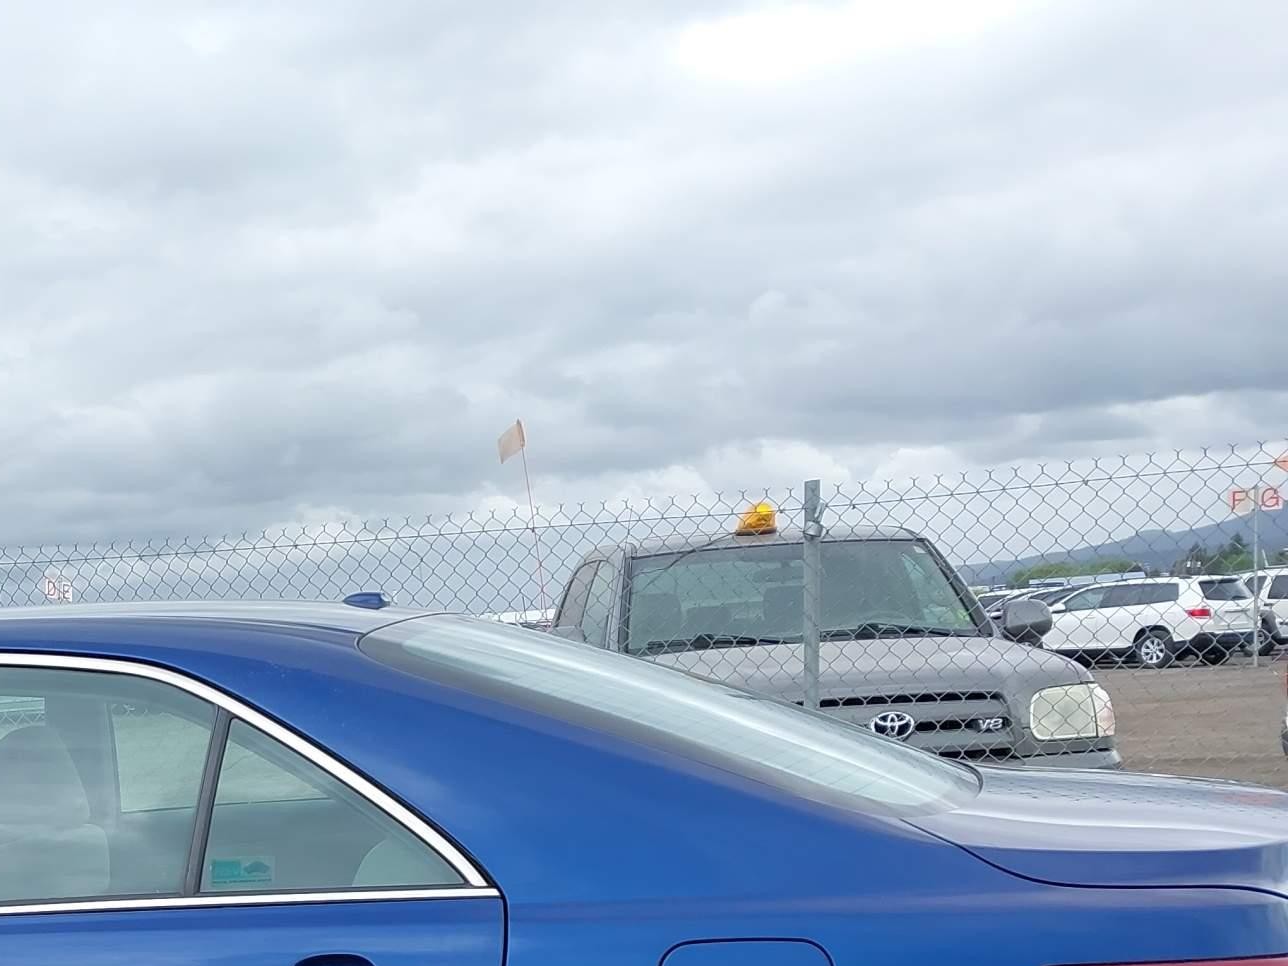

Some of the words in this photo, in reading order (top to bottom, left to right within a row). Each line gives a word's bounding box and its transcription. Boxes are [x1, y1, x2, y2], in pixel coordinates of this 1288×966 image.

[1232, 490, 1246, 510] F
[1261, 487, 1280, 508] G
[47, 580, 57, 597] D
[62, 583, 71, 600] E
[977, 718, 1003, 730] V8
